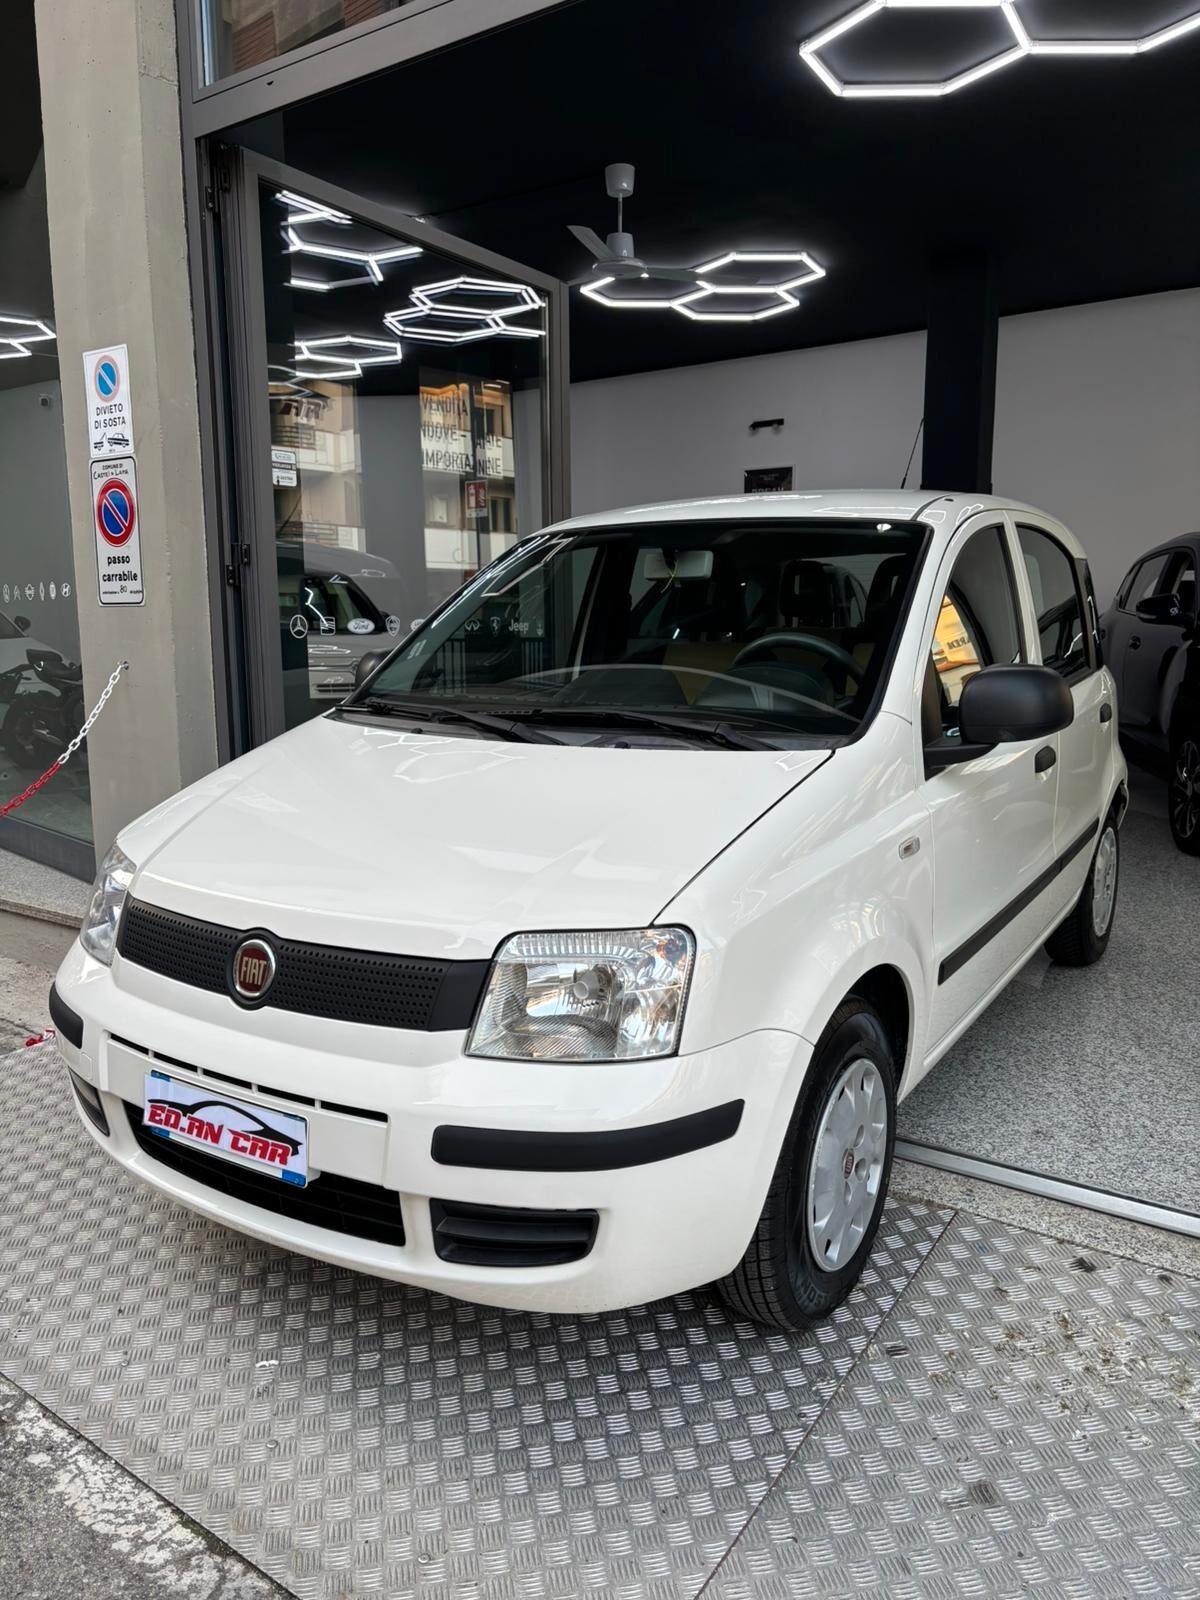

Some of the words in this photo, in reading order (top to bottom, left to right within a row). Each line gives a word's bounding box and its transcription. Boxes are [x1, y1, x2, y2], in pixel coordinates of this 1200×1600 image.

[96, 403, 123, 416] DIVIETO
[421, 395, 468, 416] VENDITA
[94, 420, 102, 429] DI
[103, 416, 126, 428] SOSTA
[107, 555, 130, 567] passo
[102, 571, 138, 582] carrabile
[508, 618, 529, 635] Jeep
[240, 956, 267, 986] FIAT
[226, 1128, 292, 1166] CAR
